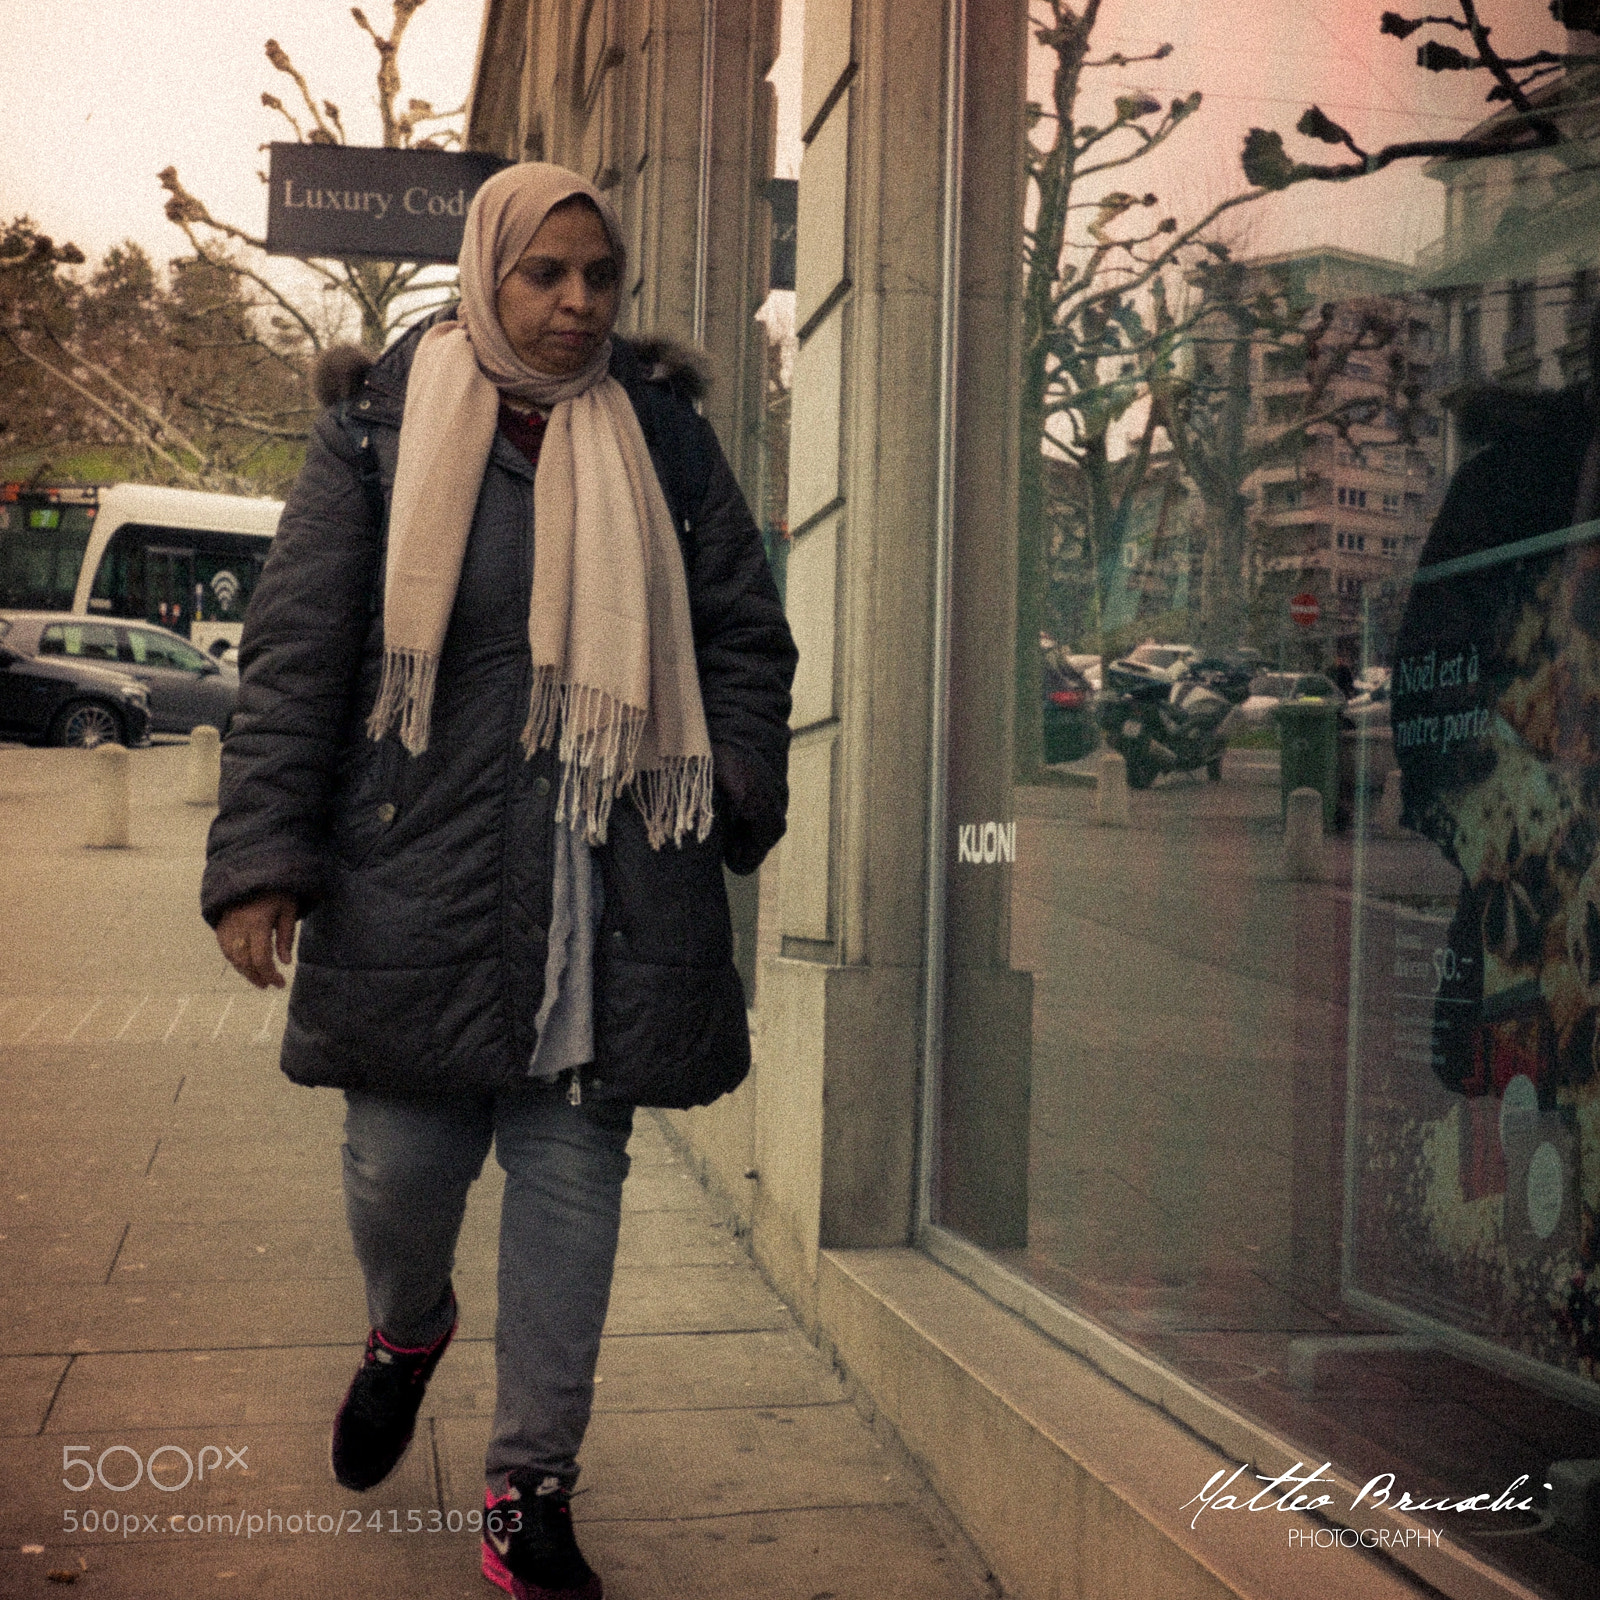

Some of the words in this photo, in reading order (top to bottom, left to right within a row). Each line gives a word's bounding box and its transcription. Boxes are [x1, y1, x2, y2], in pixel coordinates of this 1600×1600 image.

[284, 180, 394, 220] Luxury
[403, 186, 472, 217] Cod
[1439, 651, 1464, 688] est
[958, 821, 1017, 864] KUONI
